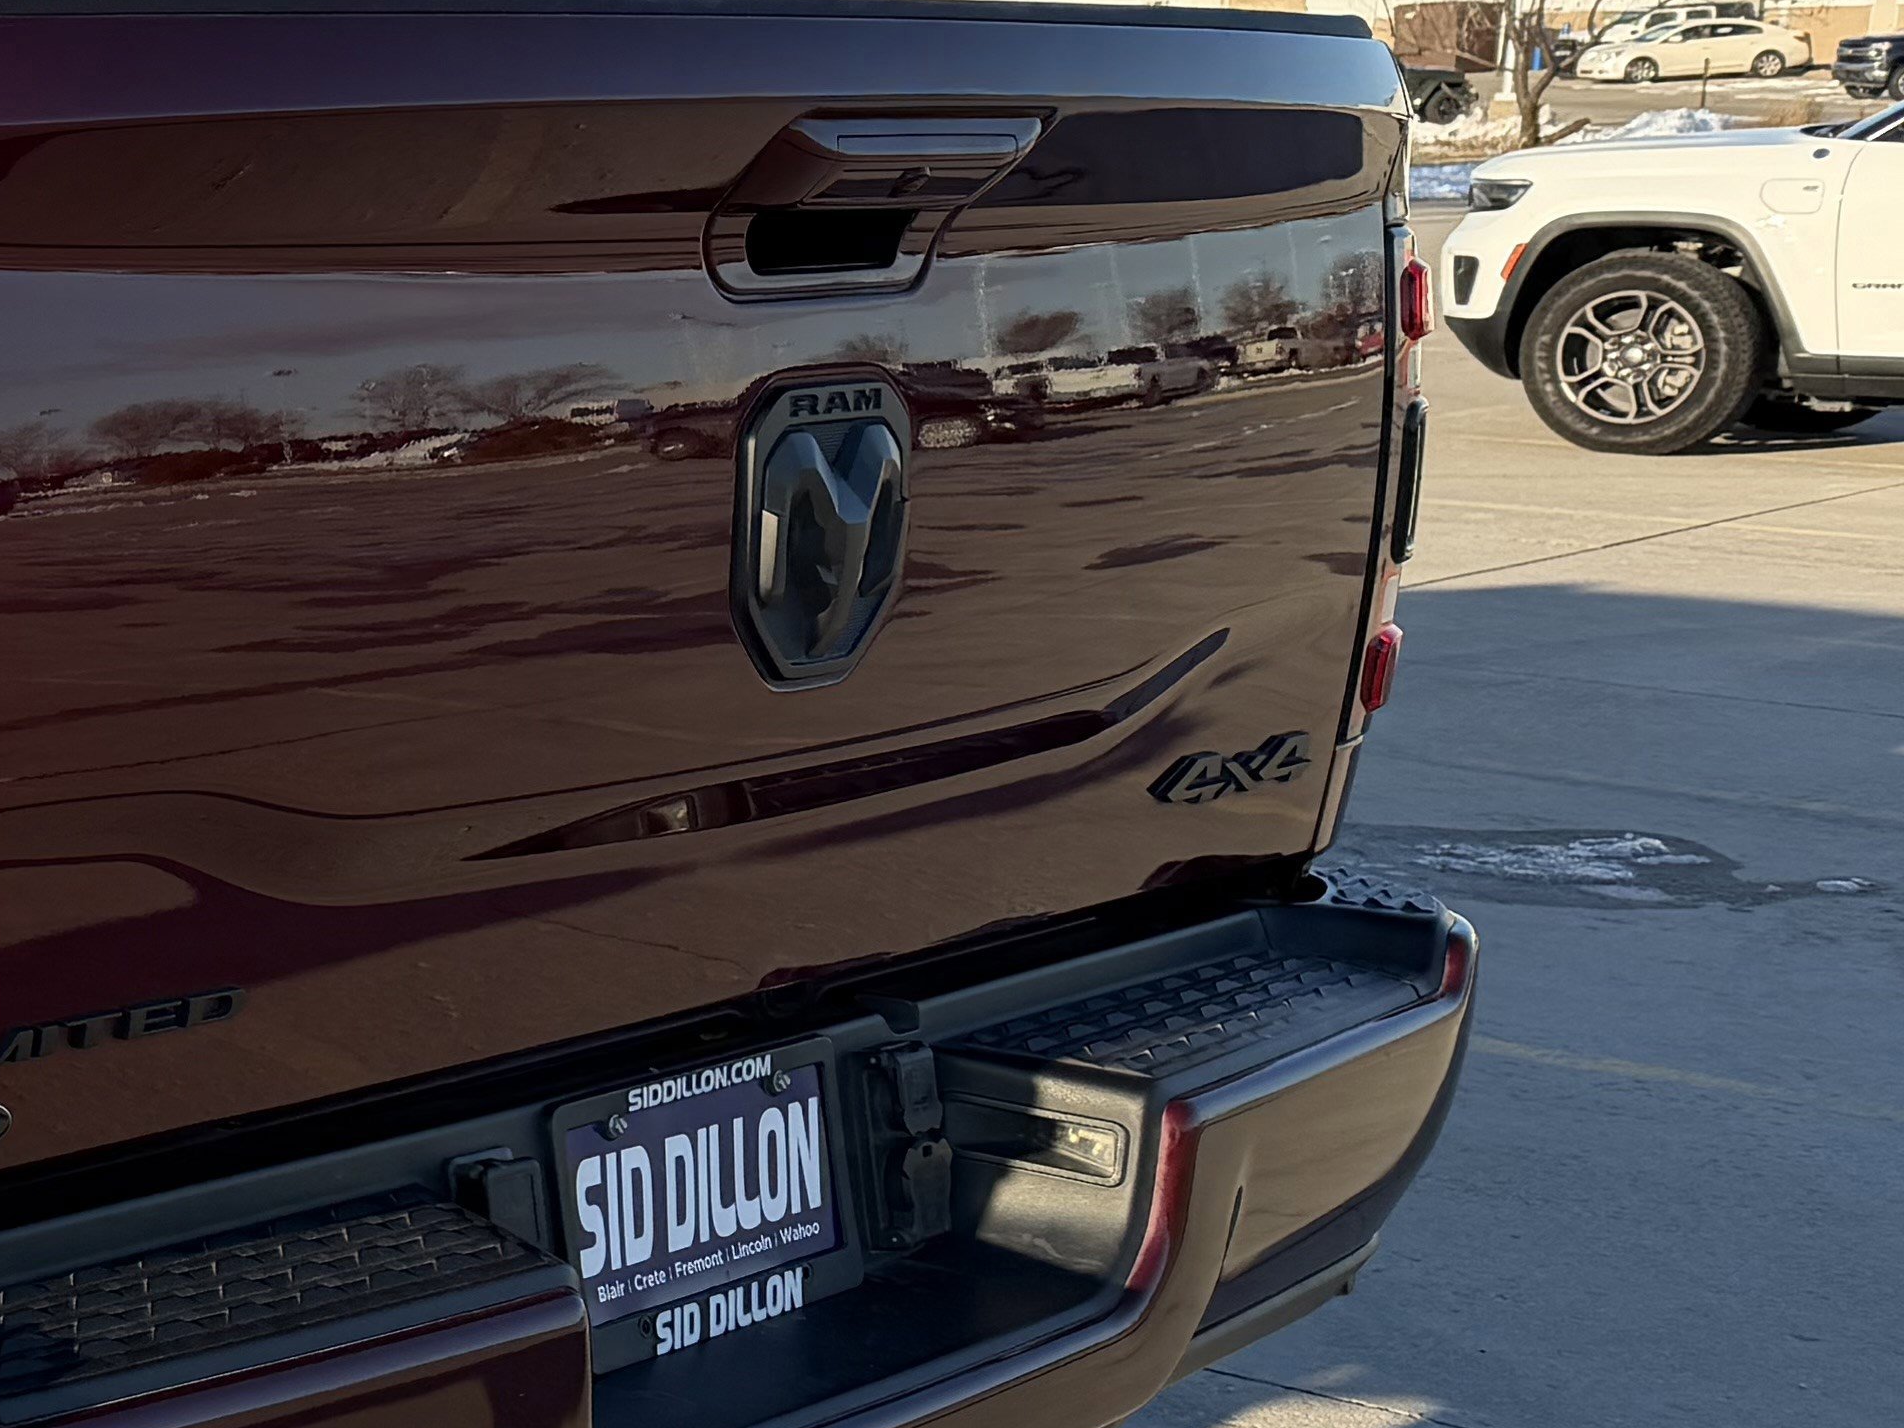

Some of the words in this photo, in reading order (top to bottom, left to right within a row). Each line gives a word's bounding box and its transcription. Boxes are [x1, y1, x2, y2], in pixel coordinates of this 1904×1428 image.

[789, 388, 882, 417] RAM
[628, 1054, 771, 1112] SIDDILLON.COM
[576, 1145, 654, 1279] SID
[664, 1096, 822, 1253] DILLON
[598, 1282, 626, 1303] Blair
[634, 1269, 666, 1290] Crete
[674, 1249, 724, 1278] Fremont
[732, 1235, 773, 1261] Lincoln
[779, 1222, 821, 1246] Wahoo
[656, 1303, 701, 1356] SID
[709, 1267, 805, 1338] DILLON
